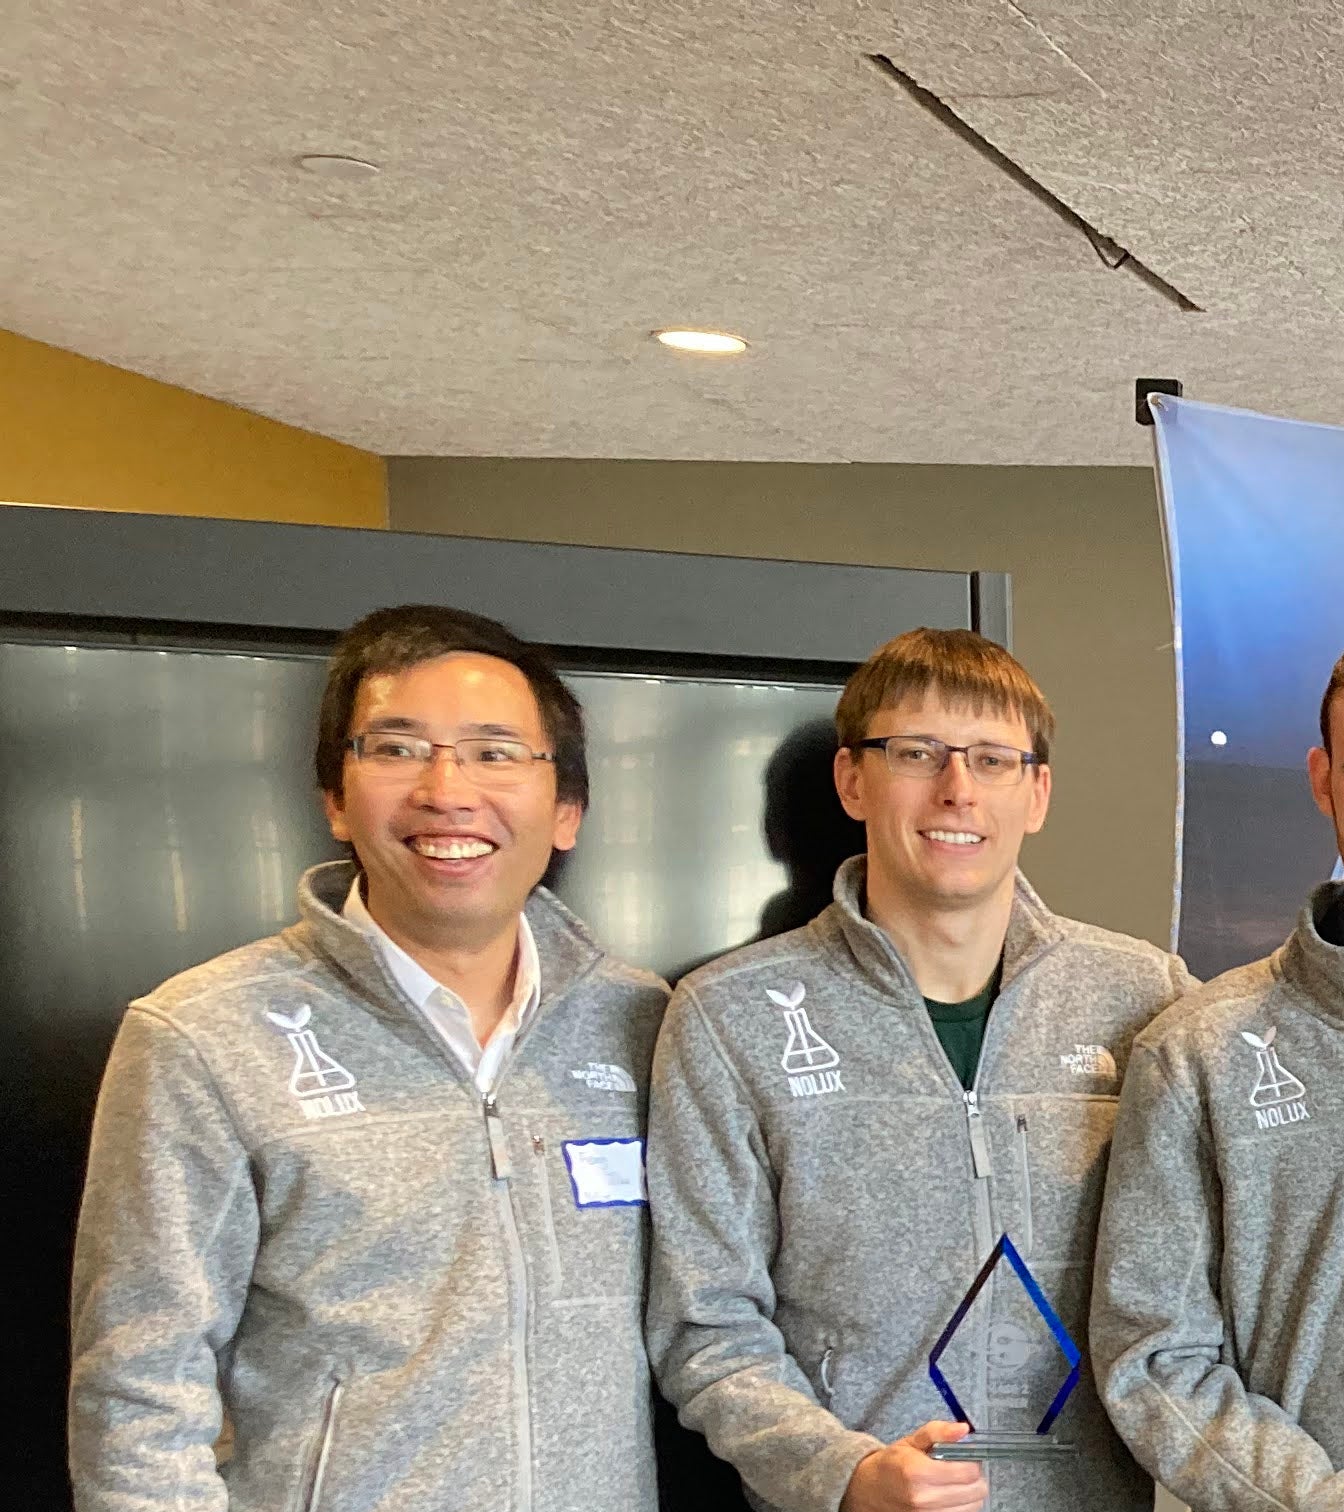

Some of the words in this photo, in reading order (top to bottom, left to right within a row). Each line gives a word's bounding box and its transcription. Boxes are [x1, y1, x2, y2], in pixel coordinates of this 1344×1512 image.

[1074, 1044, 1098, 1054] THE
[1060, 1053, 1099, 1065] NORTH
[1069, 1063, 1100, 1074] FACE
[787, 1069, 848, 1098] NOLUX
[1255, 1100, 1311, 1130] NOLUX
